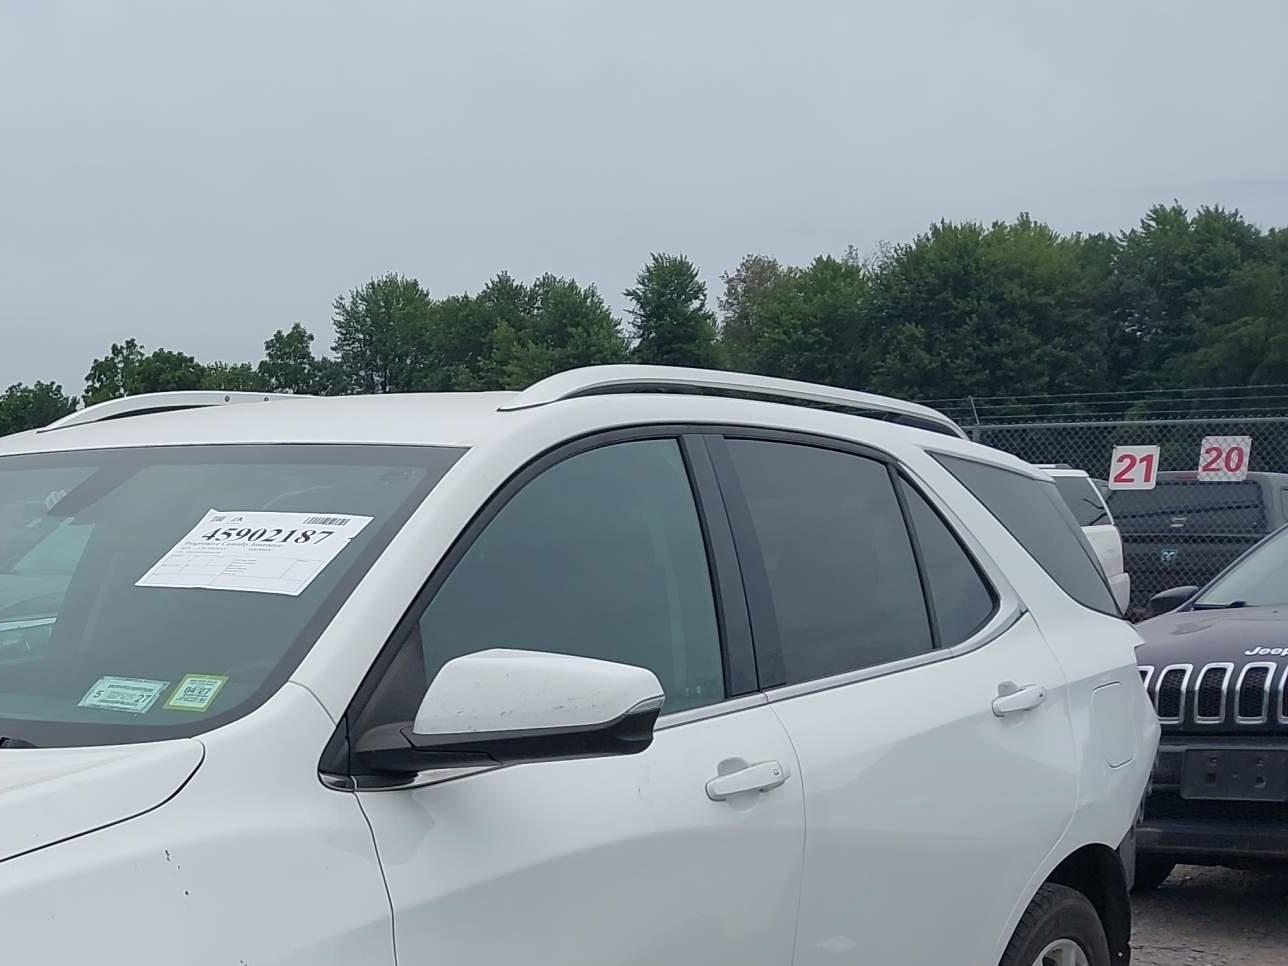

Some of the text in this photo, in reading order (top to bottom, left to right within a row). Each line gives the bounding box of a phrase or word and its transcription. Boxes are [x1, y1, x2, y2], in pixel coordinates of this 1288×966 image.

[1113, 453, 1154, 483] 21
[1202, 446, 1245, 473] 20
[201, 527, 335, 545] 45902187
